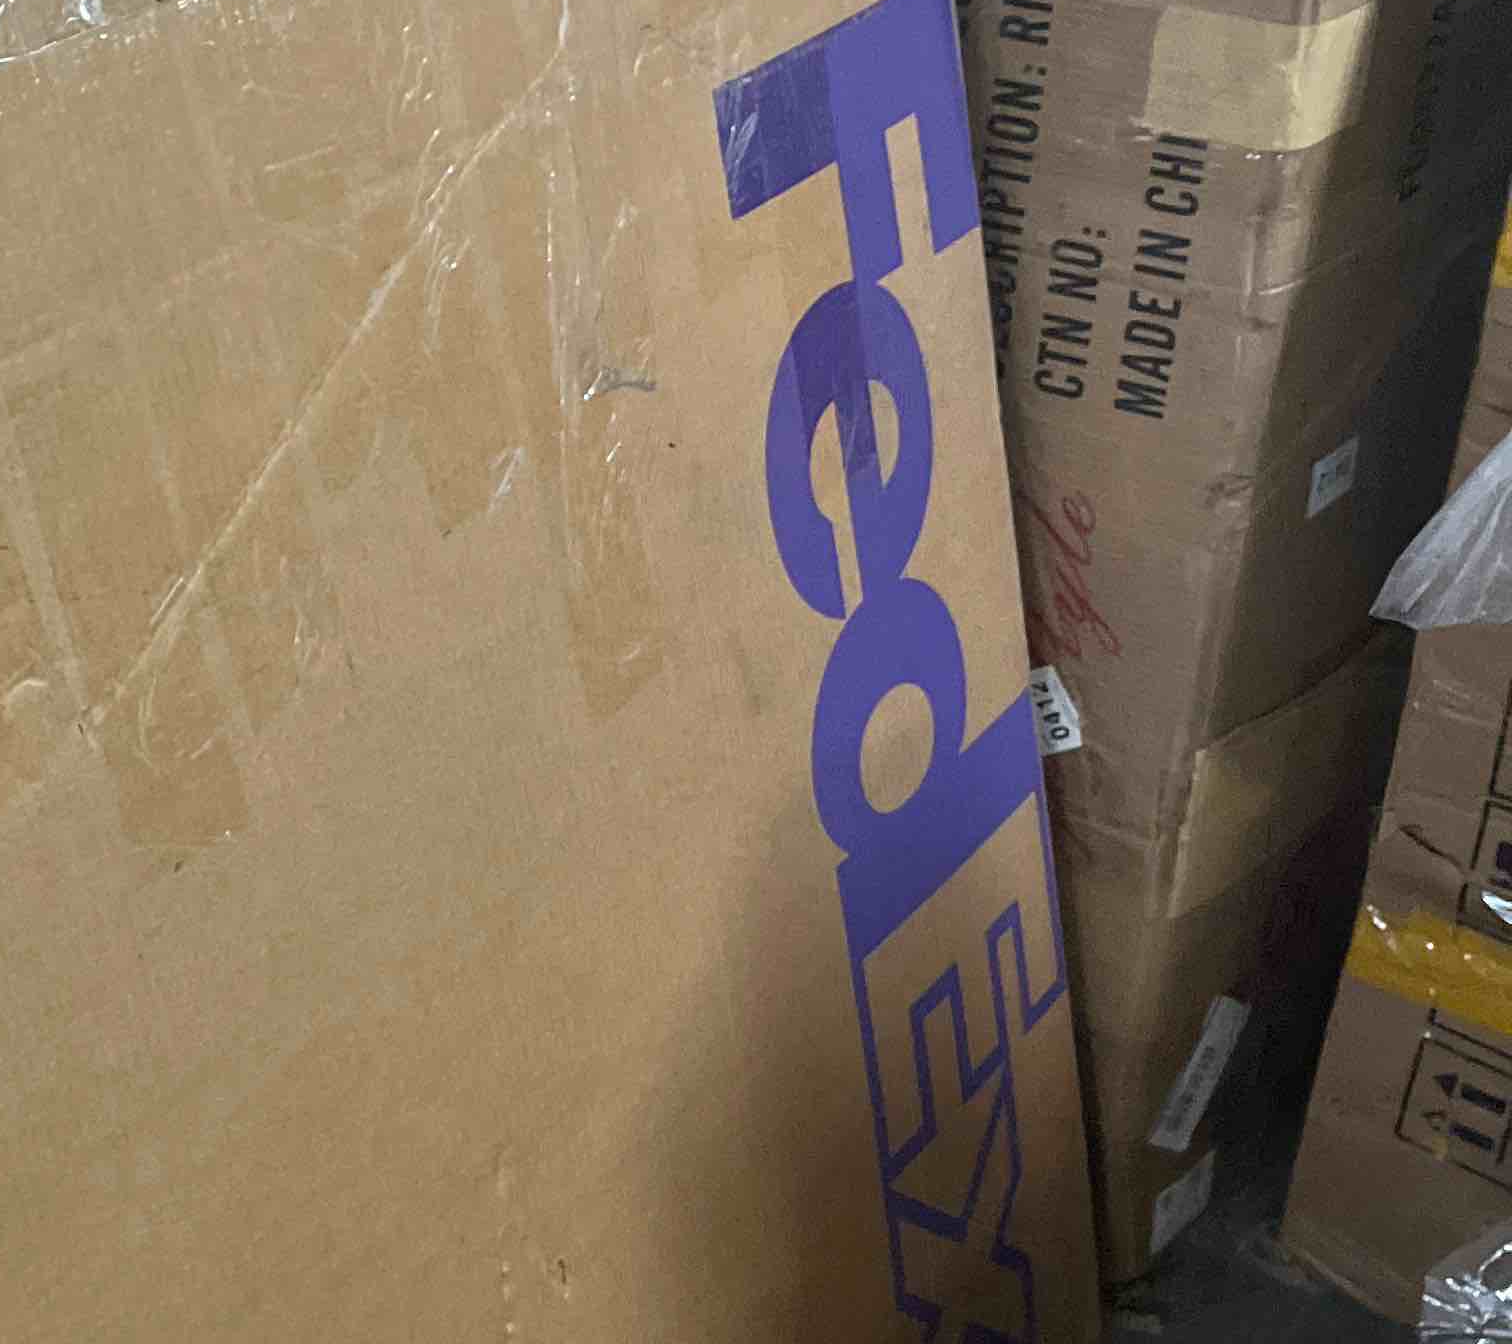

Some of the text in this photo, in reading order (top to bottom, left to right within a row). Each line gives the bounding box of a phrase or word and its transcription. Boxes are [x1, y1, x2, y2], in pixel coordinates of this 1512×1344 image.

[1034, 227, 1107, 400] CTN NO:
[1134, 228, 1193, 281] IN
[1112, 290, 1182, 419] MADE
